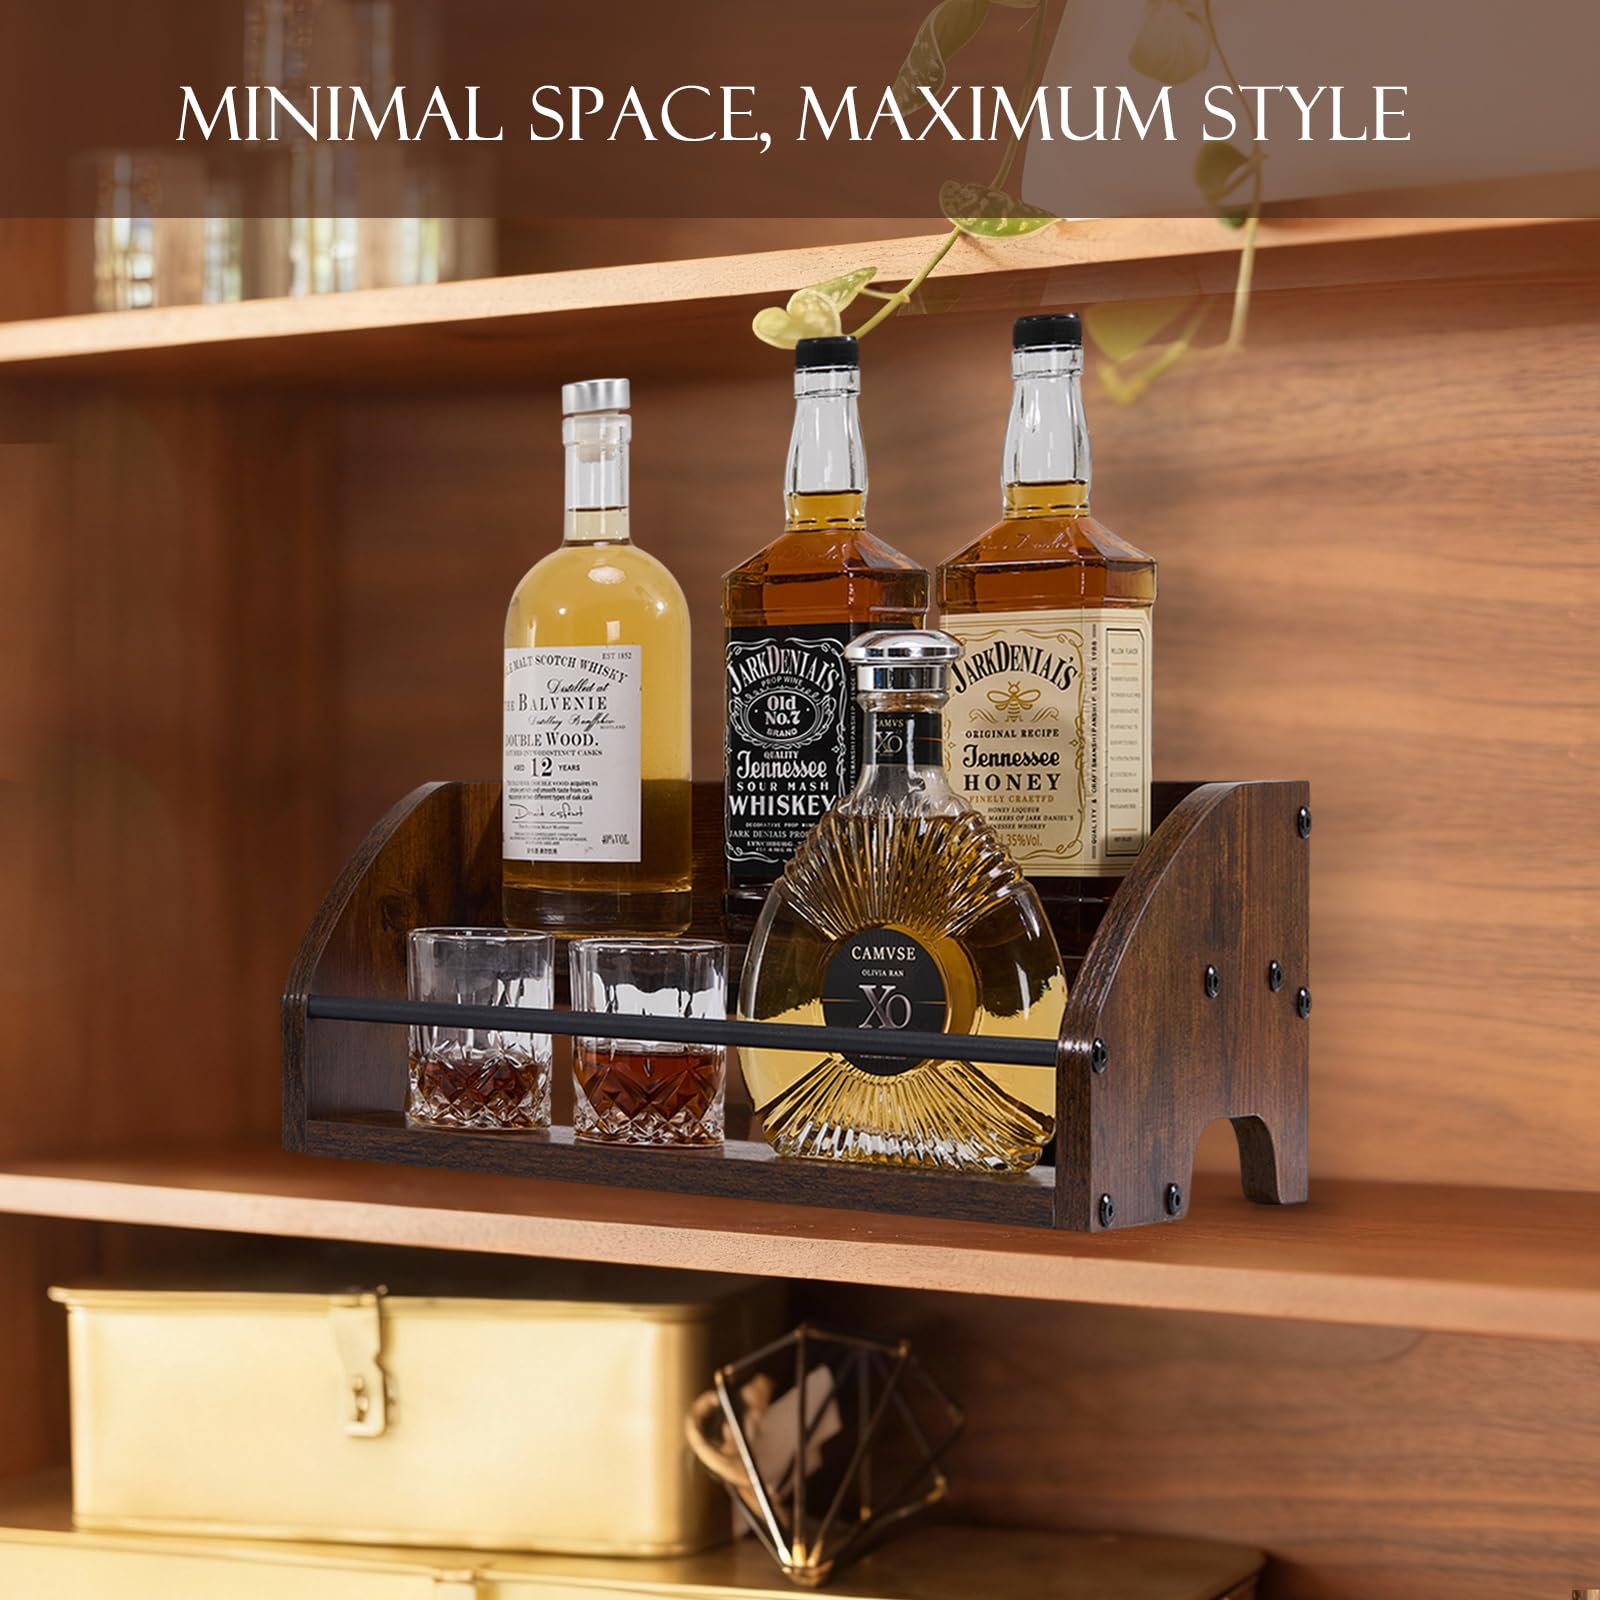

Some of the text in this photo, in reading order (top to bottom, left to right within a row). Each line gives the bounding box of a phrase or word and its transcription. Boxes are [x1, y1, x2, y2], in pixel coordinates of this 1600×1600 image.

[534, 654, 577, 669] SCOTCH
[580, 659, 628, 684] WHISKY
[519, 693, 607, 711] BALVENIE
[767, 695, 796, 711] Old
[764, 711, 801, 725] No.7
[546, 731, 599, 747] WOOD.
[766, 728, 798, 737] BRAND
[965, 728, 1060, 739] ORIGINAL RECIPE
[763, 751, 799, 759] QUALITY
[963, 744, 1060, 768] Tennessee
[531, 757, 553, 777] 12
[736, 750, 827, 779] Tennessee
[736, 781, 829, 792] SOUR MASH
[964, 773, 1061, 791] HONEY
[728, 794, 837, 816] WHISKEY
[851, 946, 916, 960] CAMVSE
